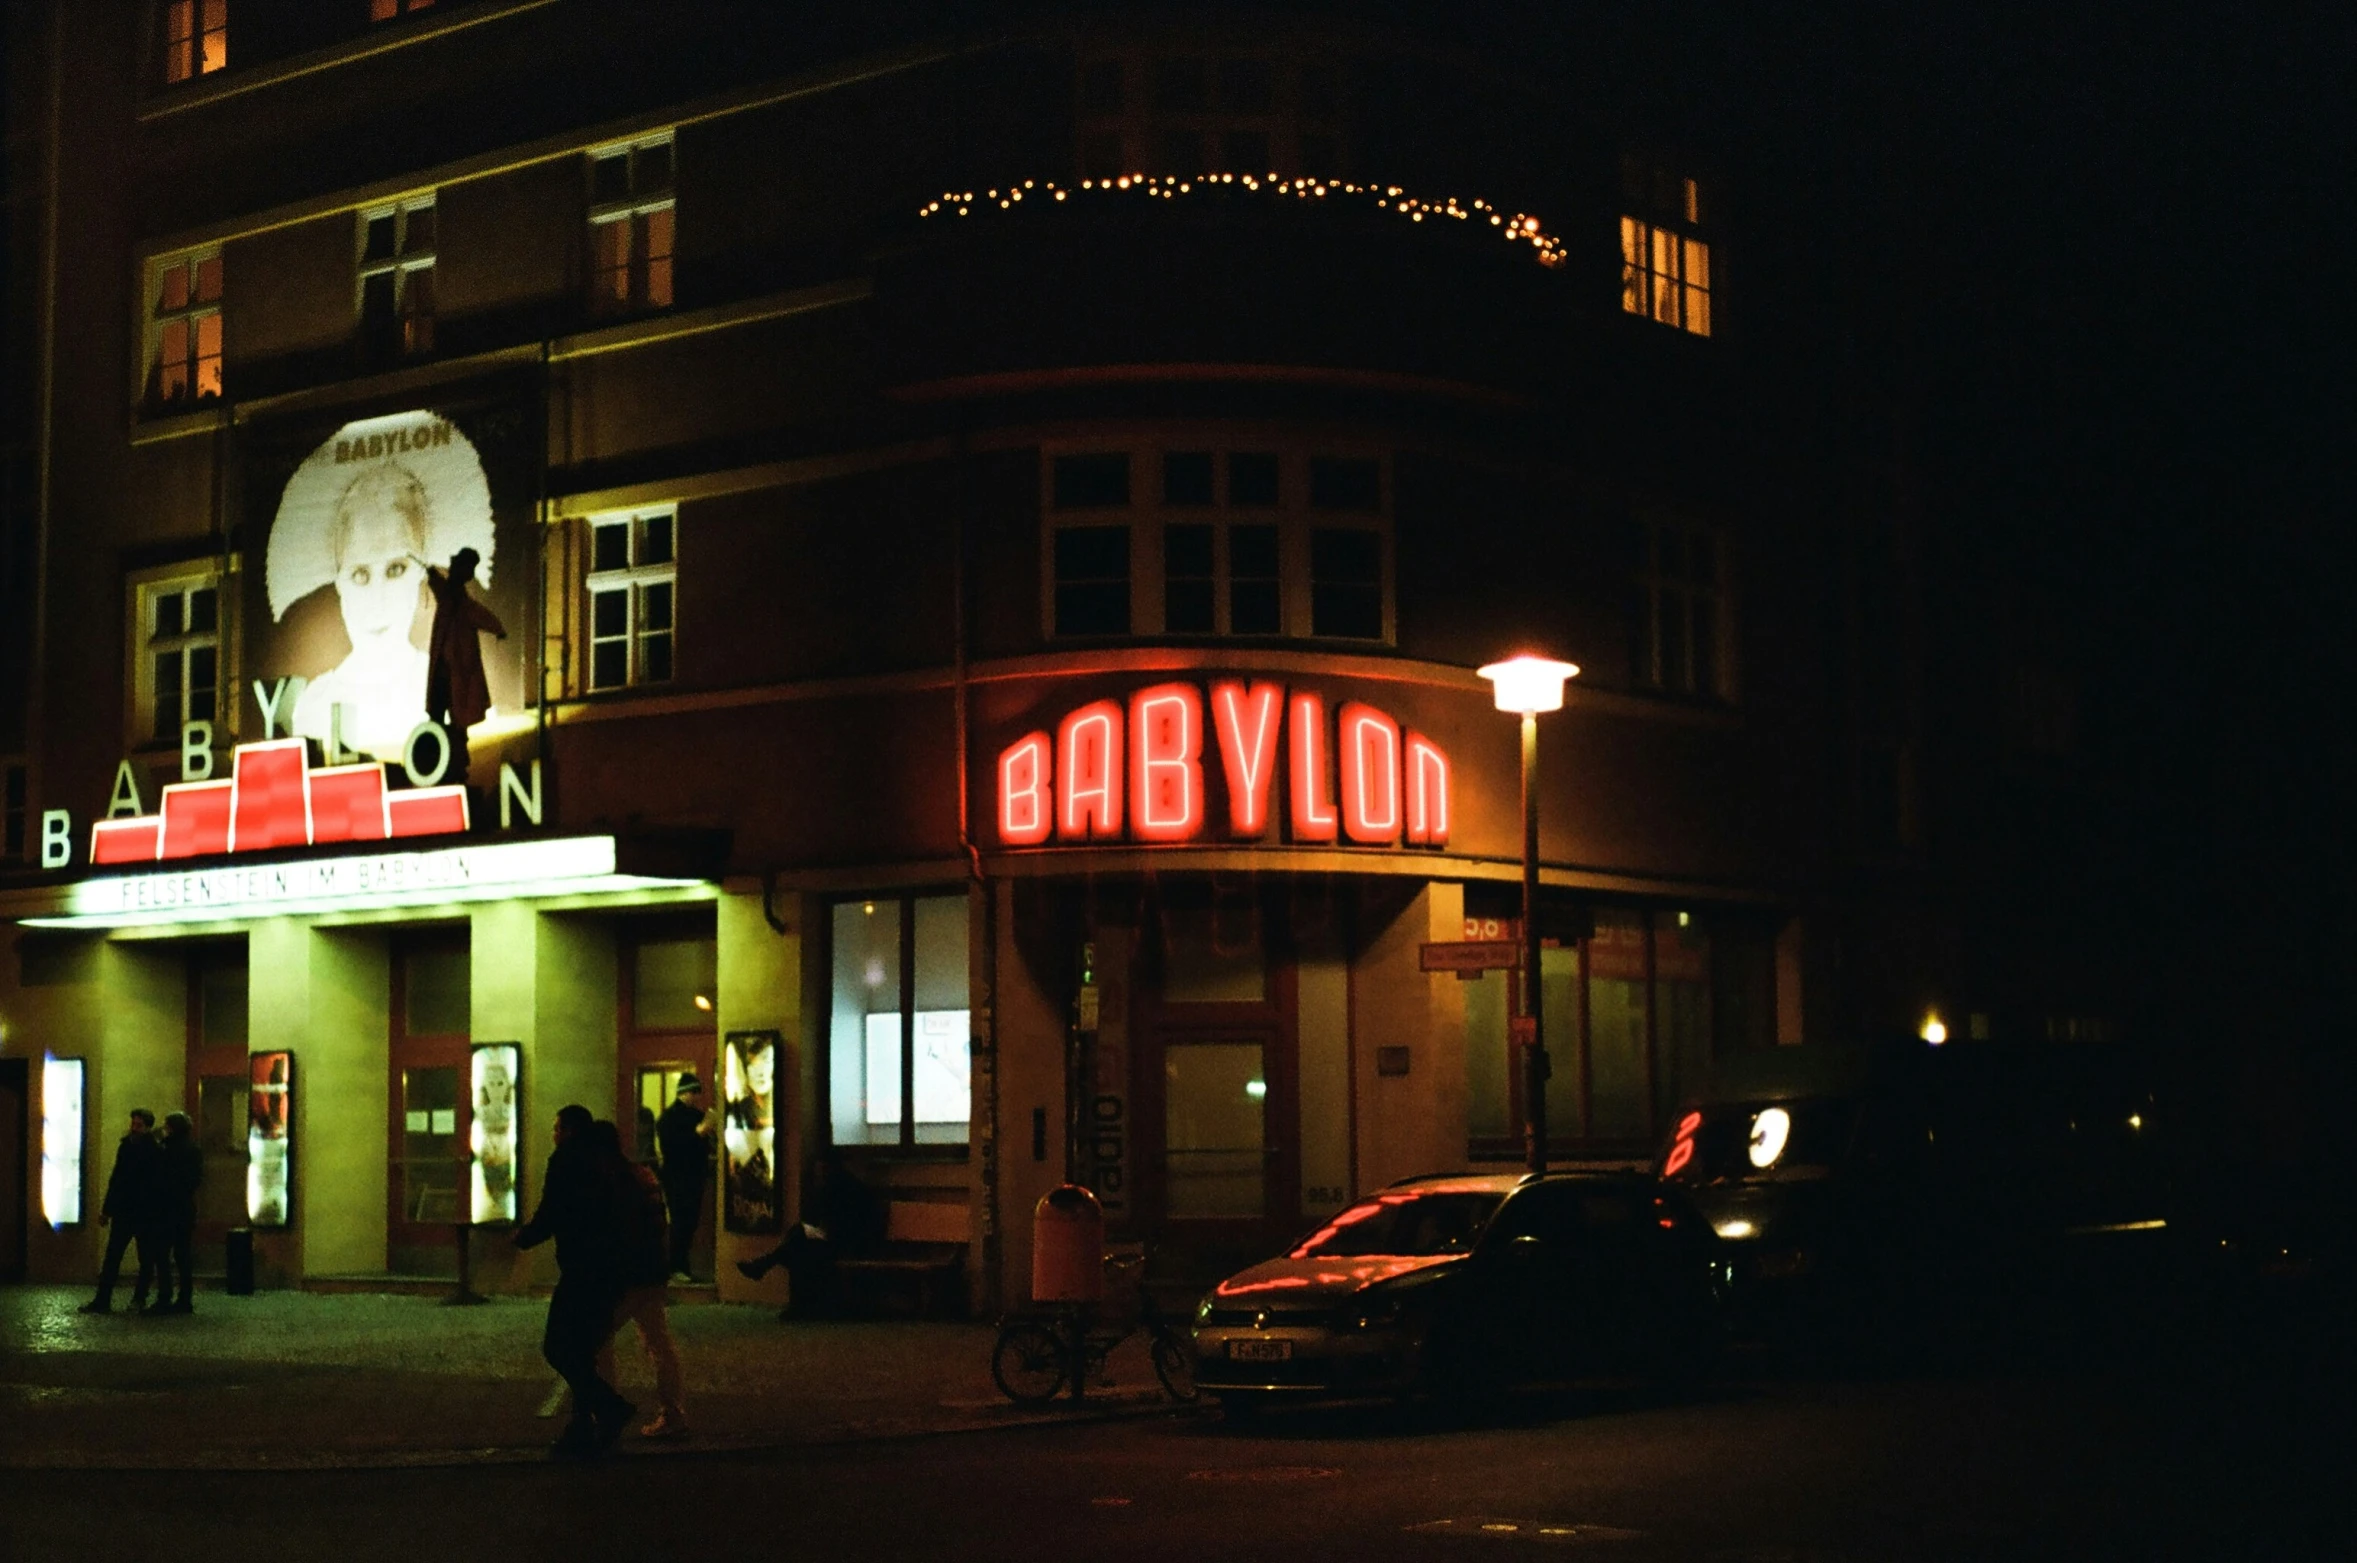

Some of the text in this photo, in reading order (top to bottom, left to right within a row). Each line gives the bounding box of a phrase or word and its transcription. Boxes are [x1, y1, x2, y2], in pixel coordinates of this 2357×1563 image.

[335, 422, 451, 463] BABYLON
[999, 678, 1450, 847] BABYLON
[121, 854, 472, 909] FELSENSTEIN IM BABYLON
